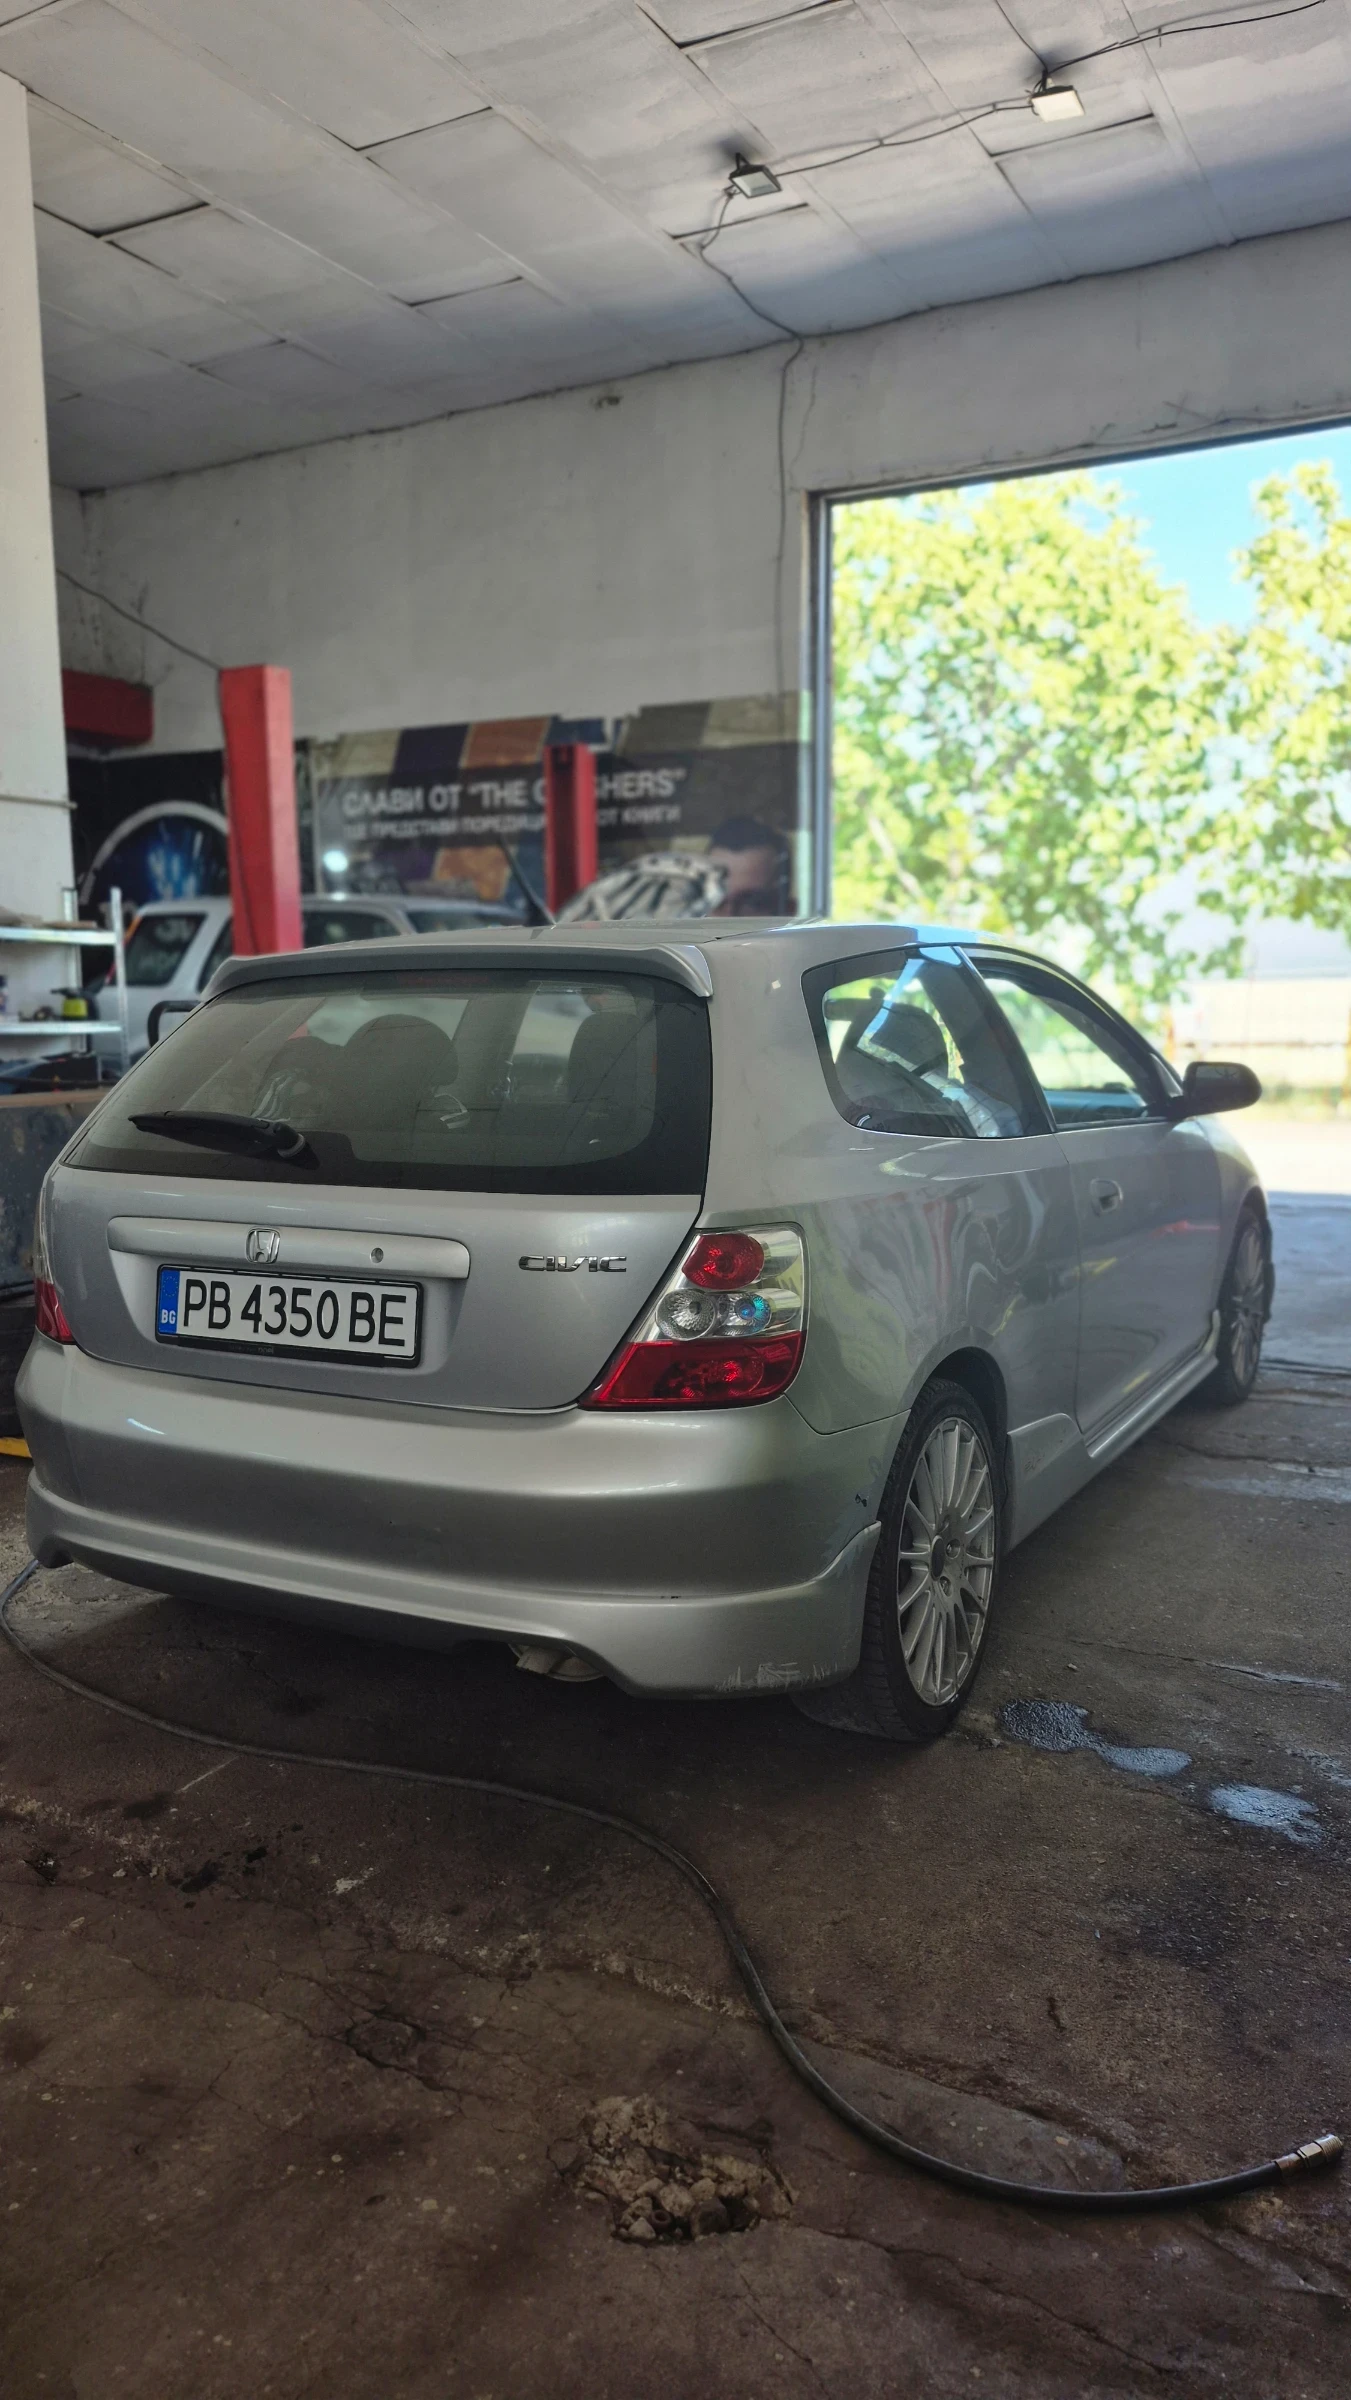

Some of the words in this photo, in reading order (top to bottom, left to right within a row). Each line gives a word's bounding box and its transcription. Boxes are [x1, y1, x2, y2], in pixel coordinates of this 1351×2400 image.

[428, 783, 463, 812] ОТ
[518, 1255, 627, 1272] CIVIC
[161, 1308, 177, 1325] BG
[183, 1278, 232, 1330] PB
[240, 1283, 340, 1340] 4350
[348, 1291, 407, 1347] BE
